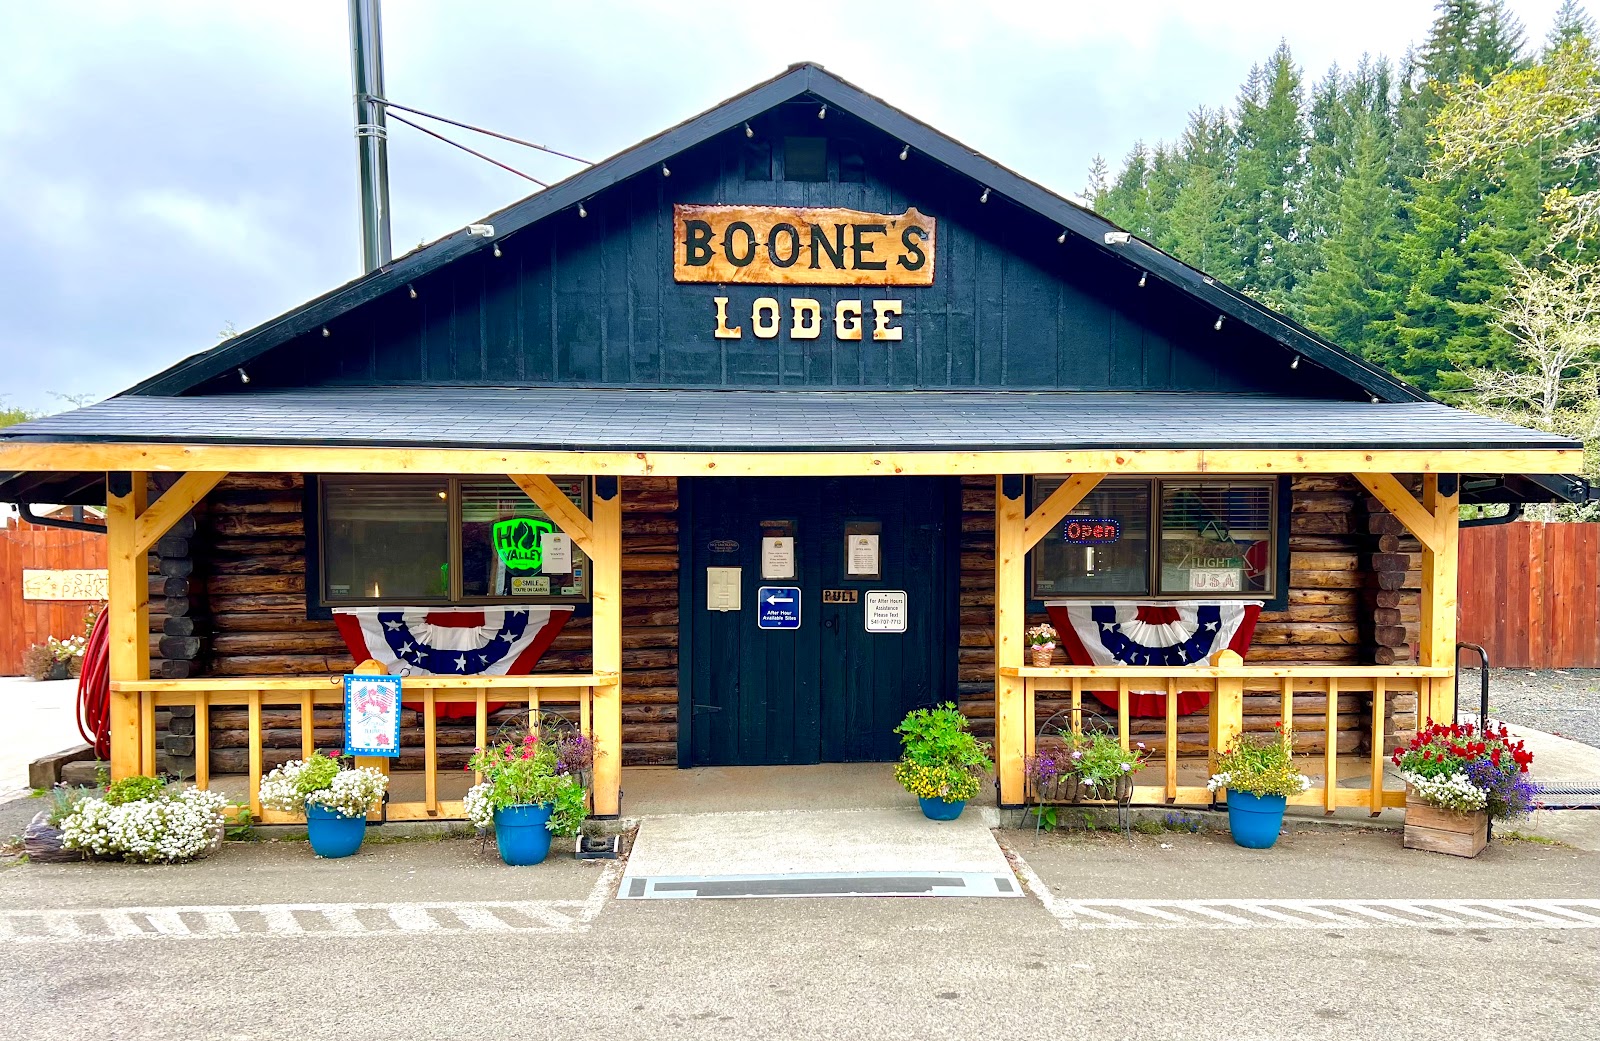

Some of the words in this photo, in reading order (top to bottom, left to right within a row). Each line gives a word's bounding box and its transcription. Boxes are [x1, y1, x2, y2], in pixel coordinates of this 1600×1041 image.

[682, 219, 926, 271] BOONE'S
[713, 296, 903, 340] LODGE
[1067, 522, 1115, 540] Open
[503, 549, 541, 561] VALLEY
[1197, 557, 1232, 568] LIGHT
[1194, 573, 1235, 588] USA
[62, 584, 109, 597] PARK
[824, 590, 855, 601] PULL
